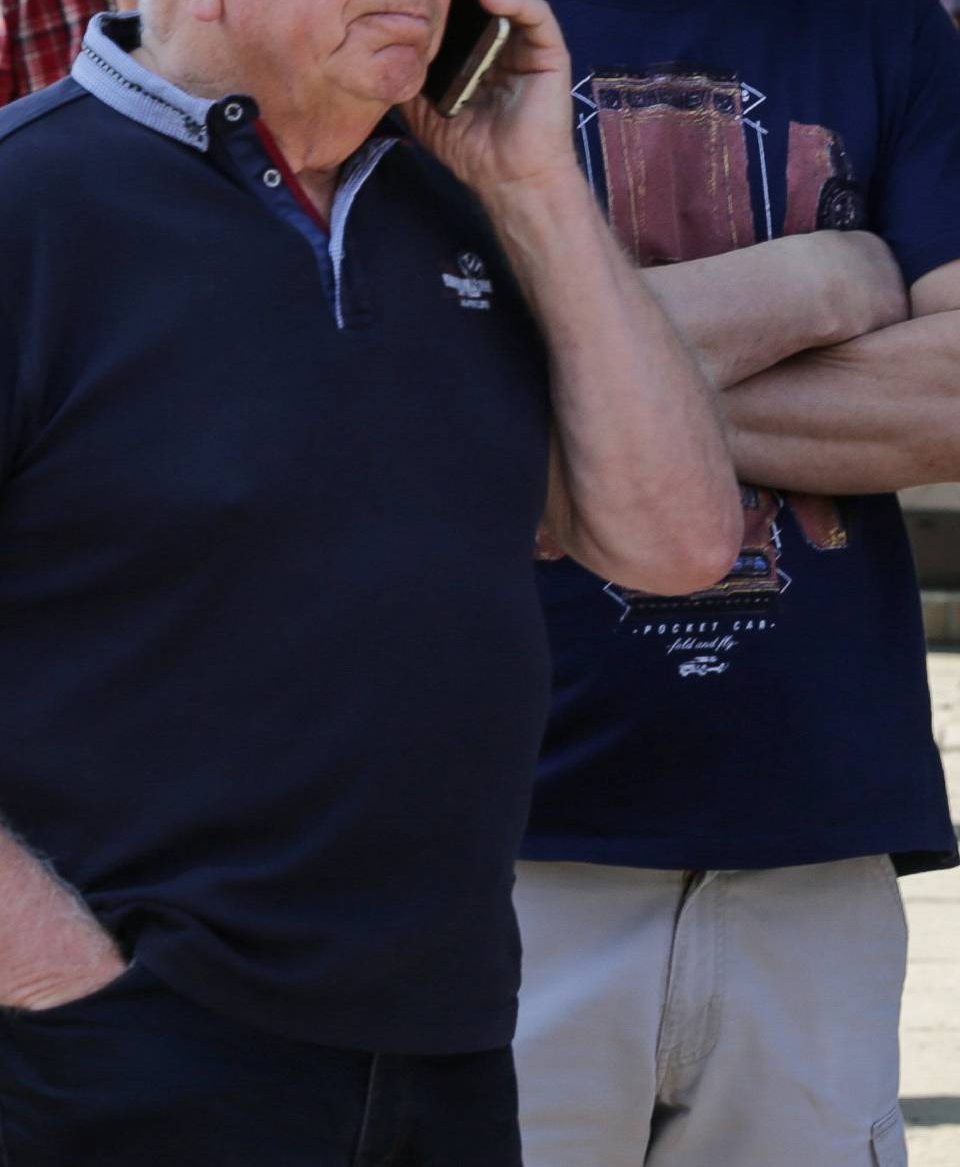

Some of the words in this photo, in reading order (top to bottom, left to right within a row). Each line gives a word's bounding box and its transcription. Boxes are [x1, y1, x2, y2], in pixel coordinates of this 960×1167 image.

[643, 621, 719, 635] POCKET
[733, 619, 767, 631] CAR
[694, 636, 720, 649] and
